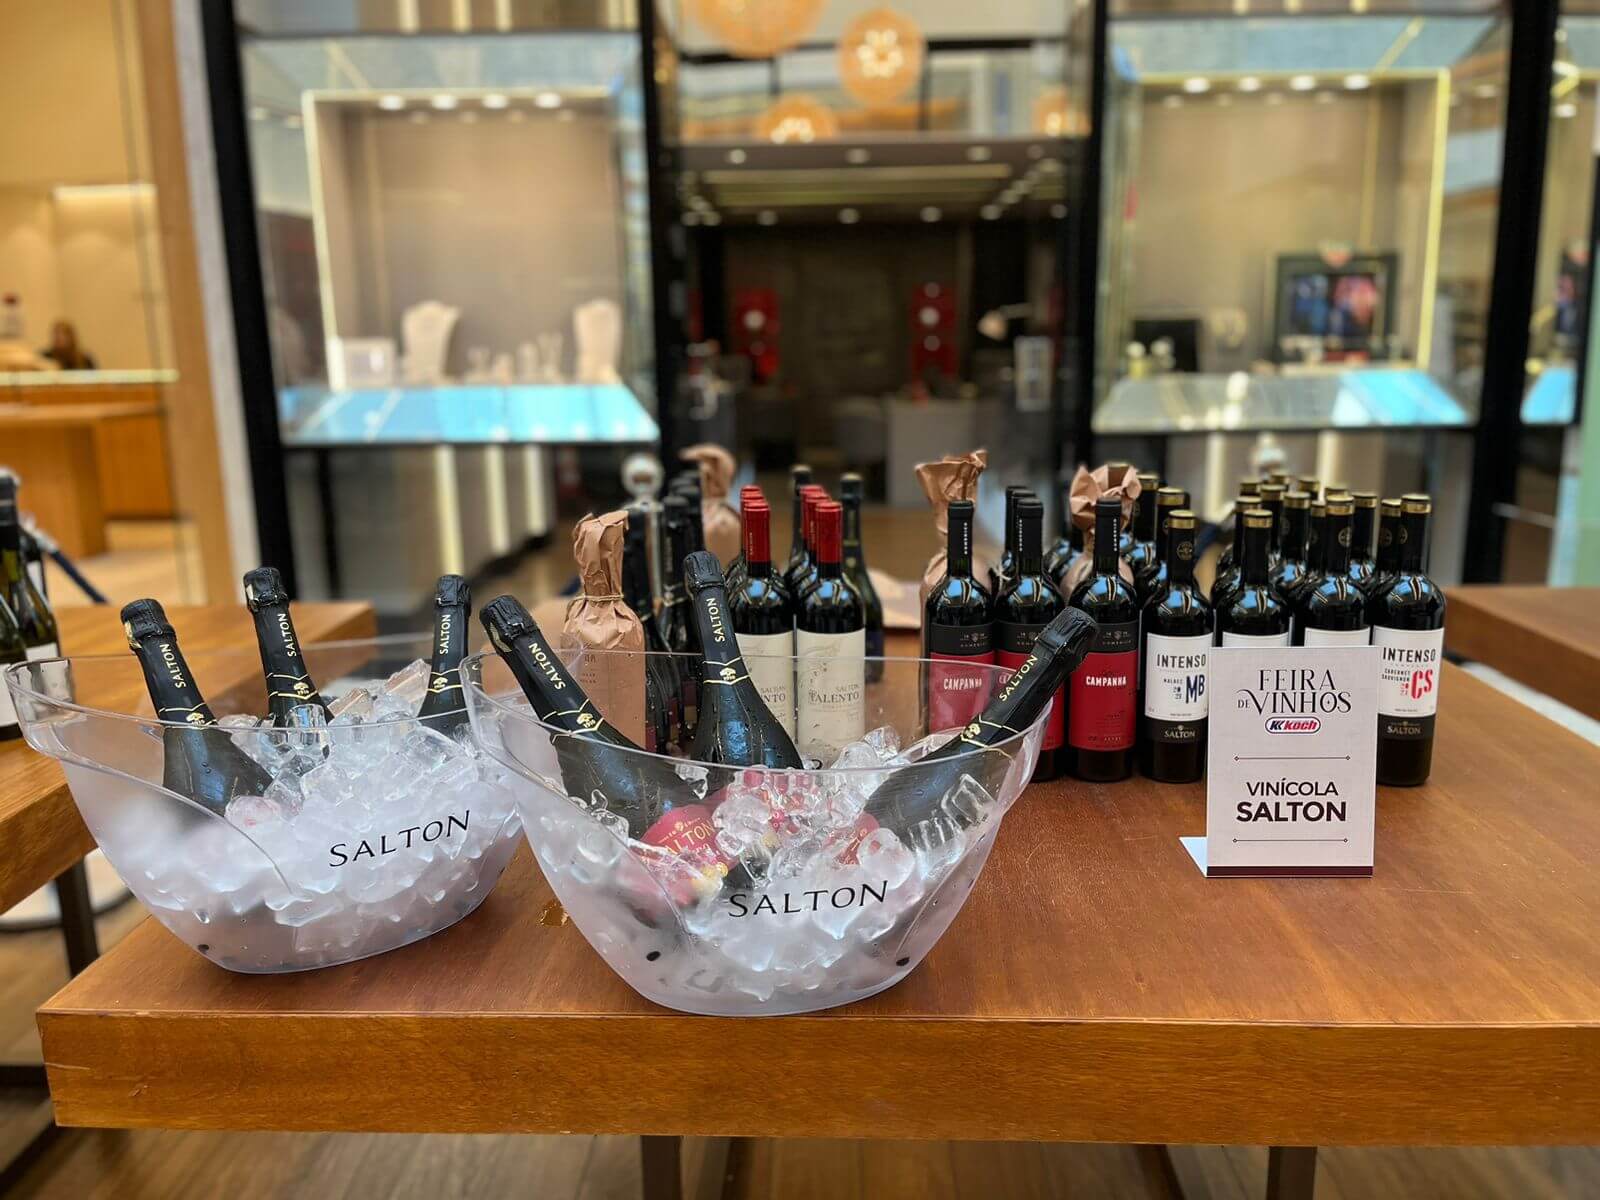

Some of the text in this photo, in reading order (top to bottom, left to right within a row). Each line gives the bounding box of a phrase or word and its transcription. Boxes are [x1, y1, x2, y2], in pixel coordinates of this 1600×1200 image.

[277, 613, 298, 657] SALTON
[439, 614, 452, 655] SALTON
[706, 597, 726, 643] SALTON
[160, 643, 187, 689] SALTON
[528, 642, 567, 690] SALTON
[1156, 653, 1207, 669] INTENSO
[1383, 647, 1437, 663] INTENSO
[999, 654, 1039, 702] SALTON
[1186, 674, 1206, 704] MB
[1259, 668, 1337, 691] FEIRA
[1411, 669, 1434, 700] CS
[810, 691, 860, 704] TALENTO
[1237, 688, 1352, 715] DE VINHOS
[1164, 730, 1196, 739] SALTON
[1387, 725, 1421, 735] SALTON
[1246, 777, 1339, 797] VINÍCOLA
[1236, 801, 1347, 823] SALTON
[328, 808, 471, 868] SALTON
[728, 880, 889, 918] SALTON
